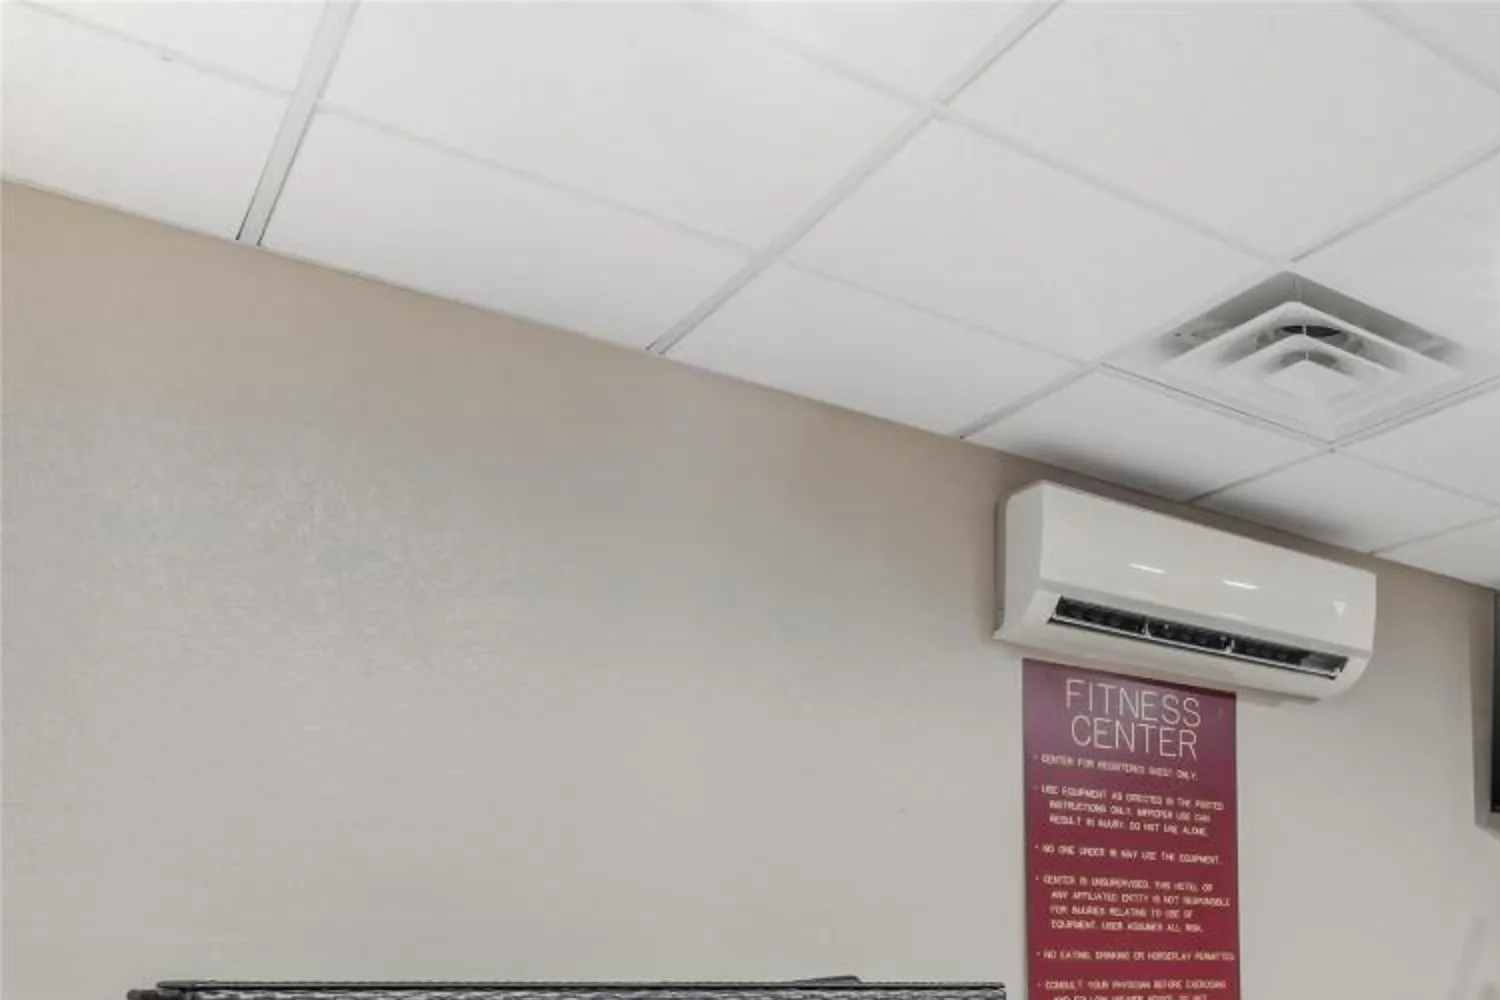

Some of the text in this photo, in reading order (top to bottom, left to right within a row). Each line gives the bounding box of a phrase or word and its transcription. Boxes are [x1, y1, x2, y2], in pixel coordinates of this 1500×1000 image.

[1065, 678, 1200, 728] FITNESS
[1071, 715, 1197, 760] CENTER
[1077, 758, 1094, 769] FOR
[1049, 800, 1107, 813] INSTRUCTIONS
[1042, 843, 1055, 854] NO
